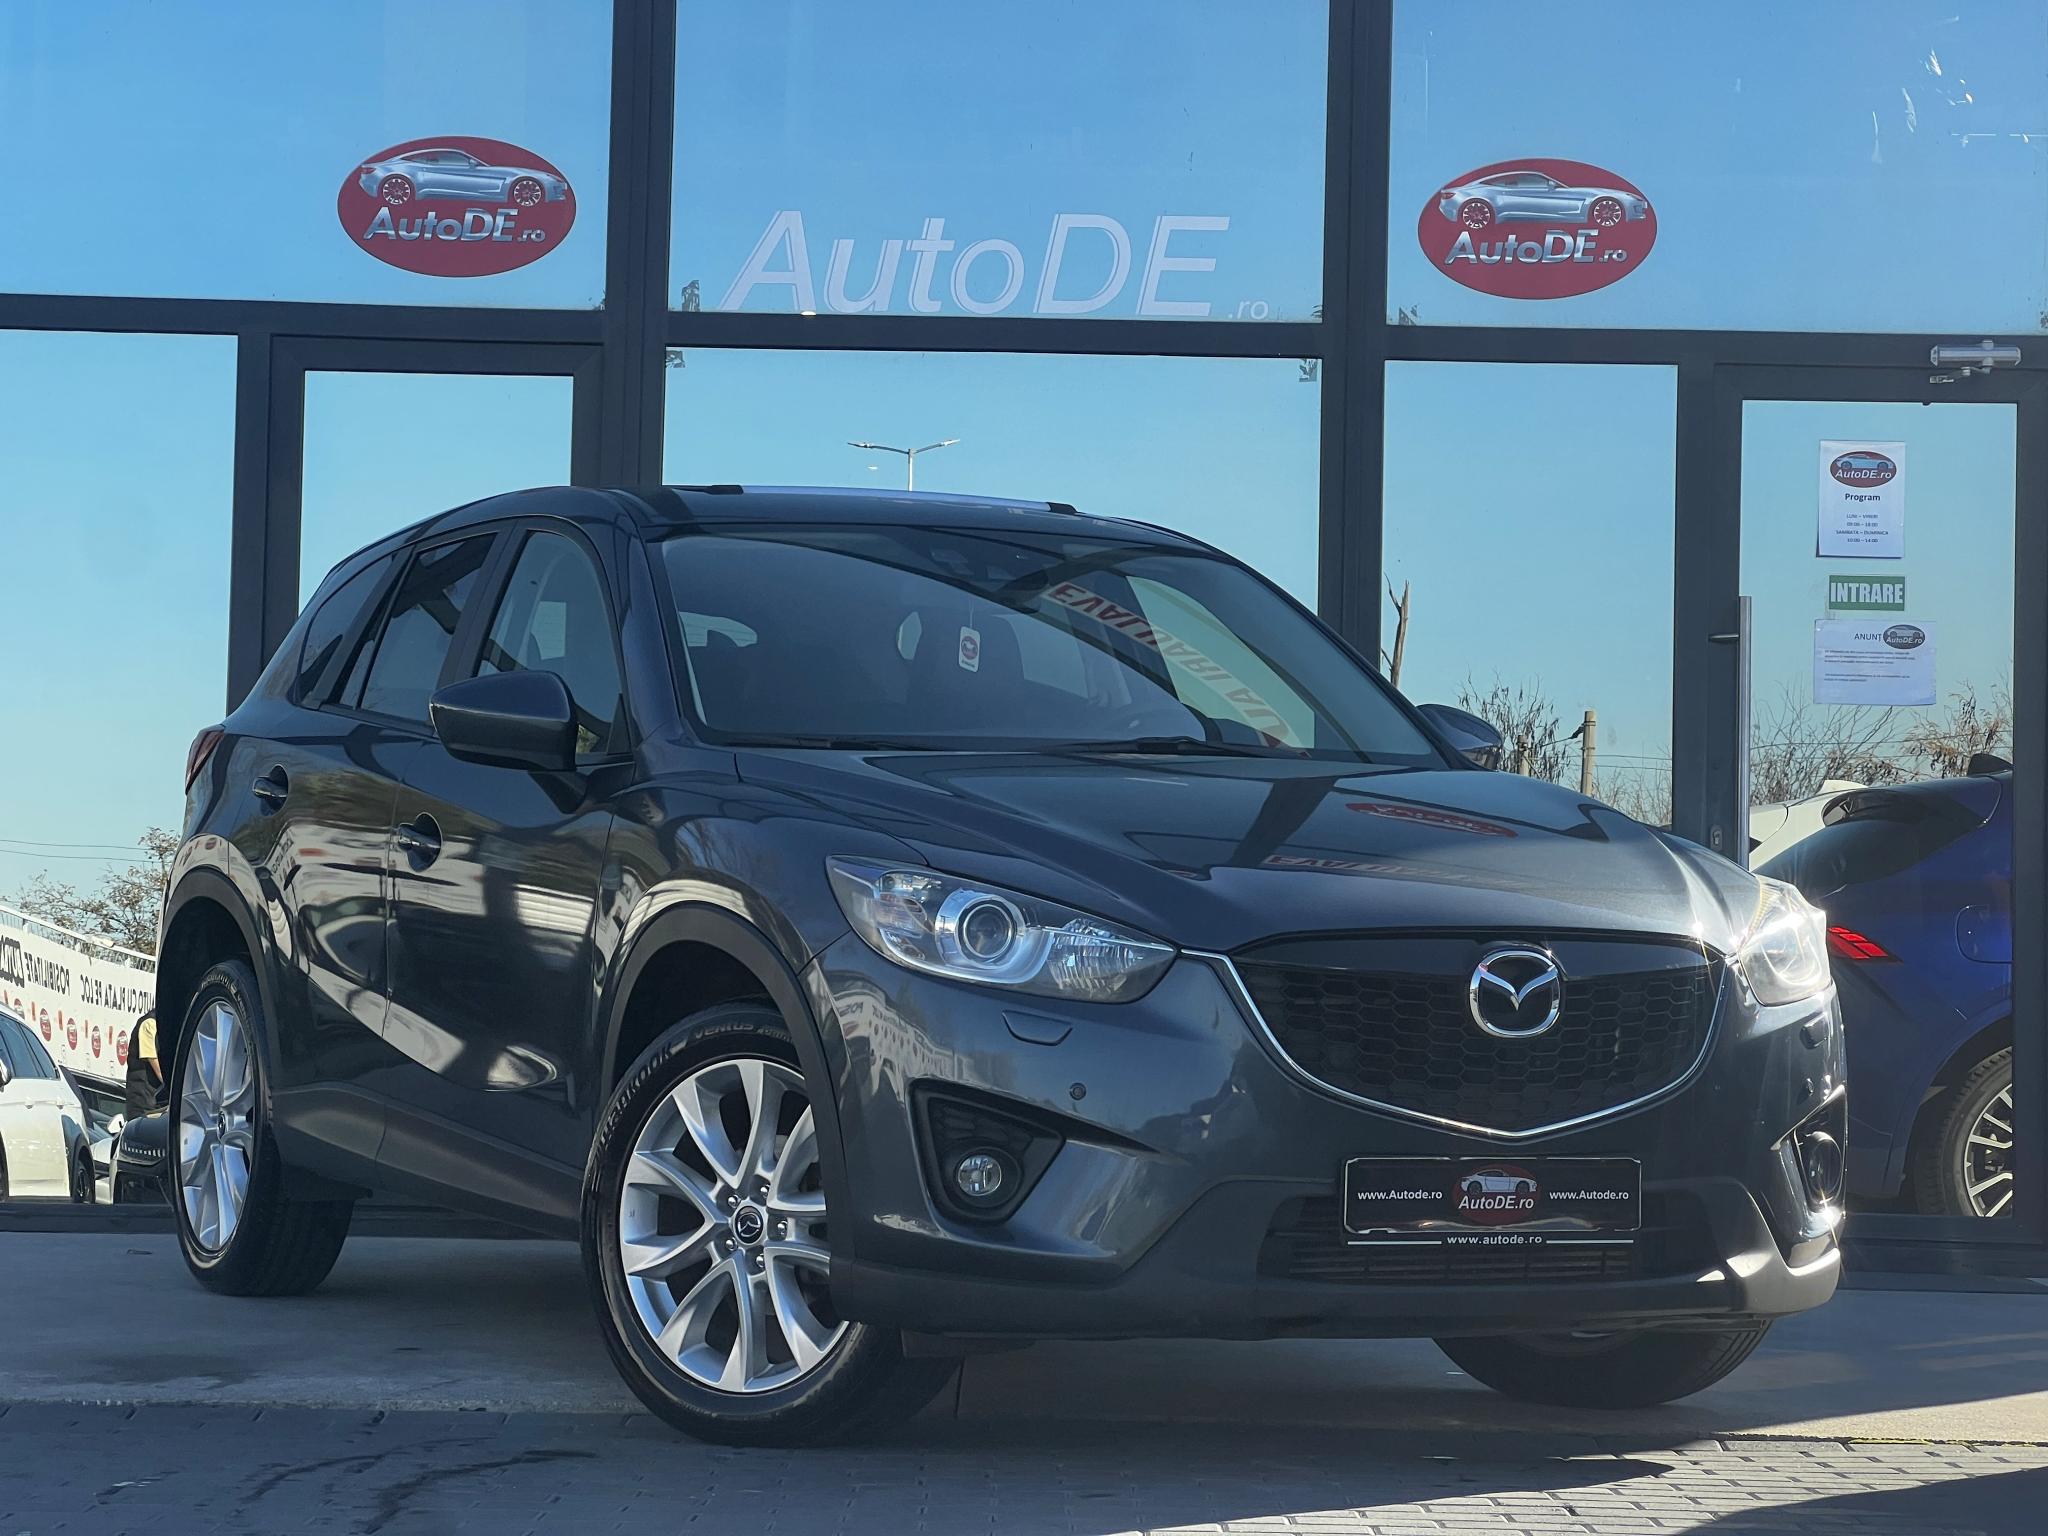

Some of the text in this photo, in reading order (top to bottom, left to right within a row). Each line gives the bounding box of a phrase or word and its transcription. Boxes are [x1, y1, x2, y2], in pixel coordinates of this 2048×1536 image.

[1835, 469, 1892, 479] AutoDE.ro
[1845, 493, 1881, 502] Program
[1830, 582, 1904, 604] INTRARE
[1357, 1189, 1629, 1210] www.Autode.ro AutoDE.ro www.Autode.ro
[1446, 1234, 1543, 1245] www.autode.ro
